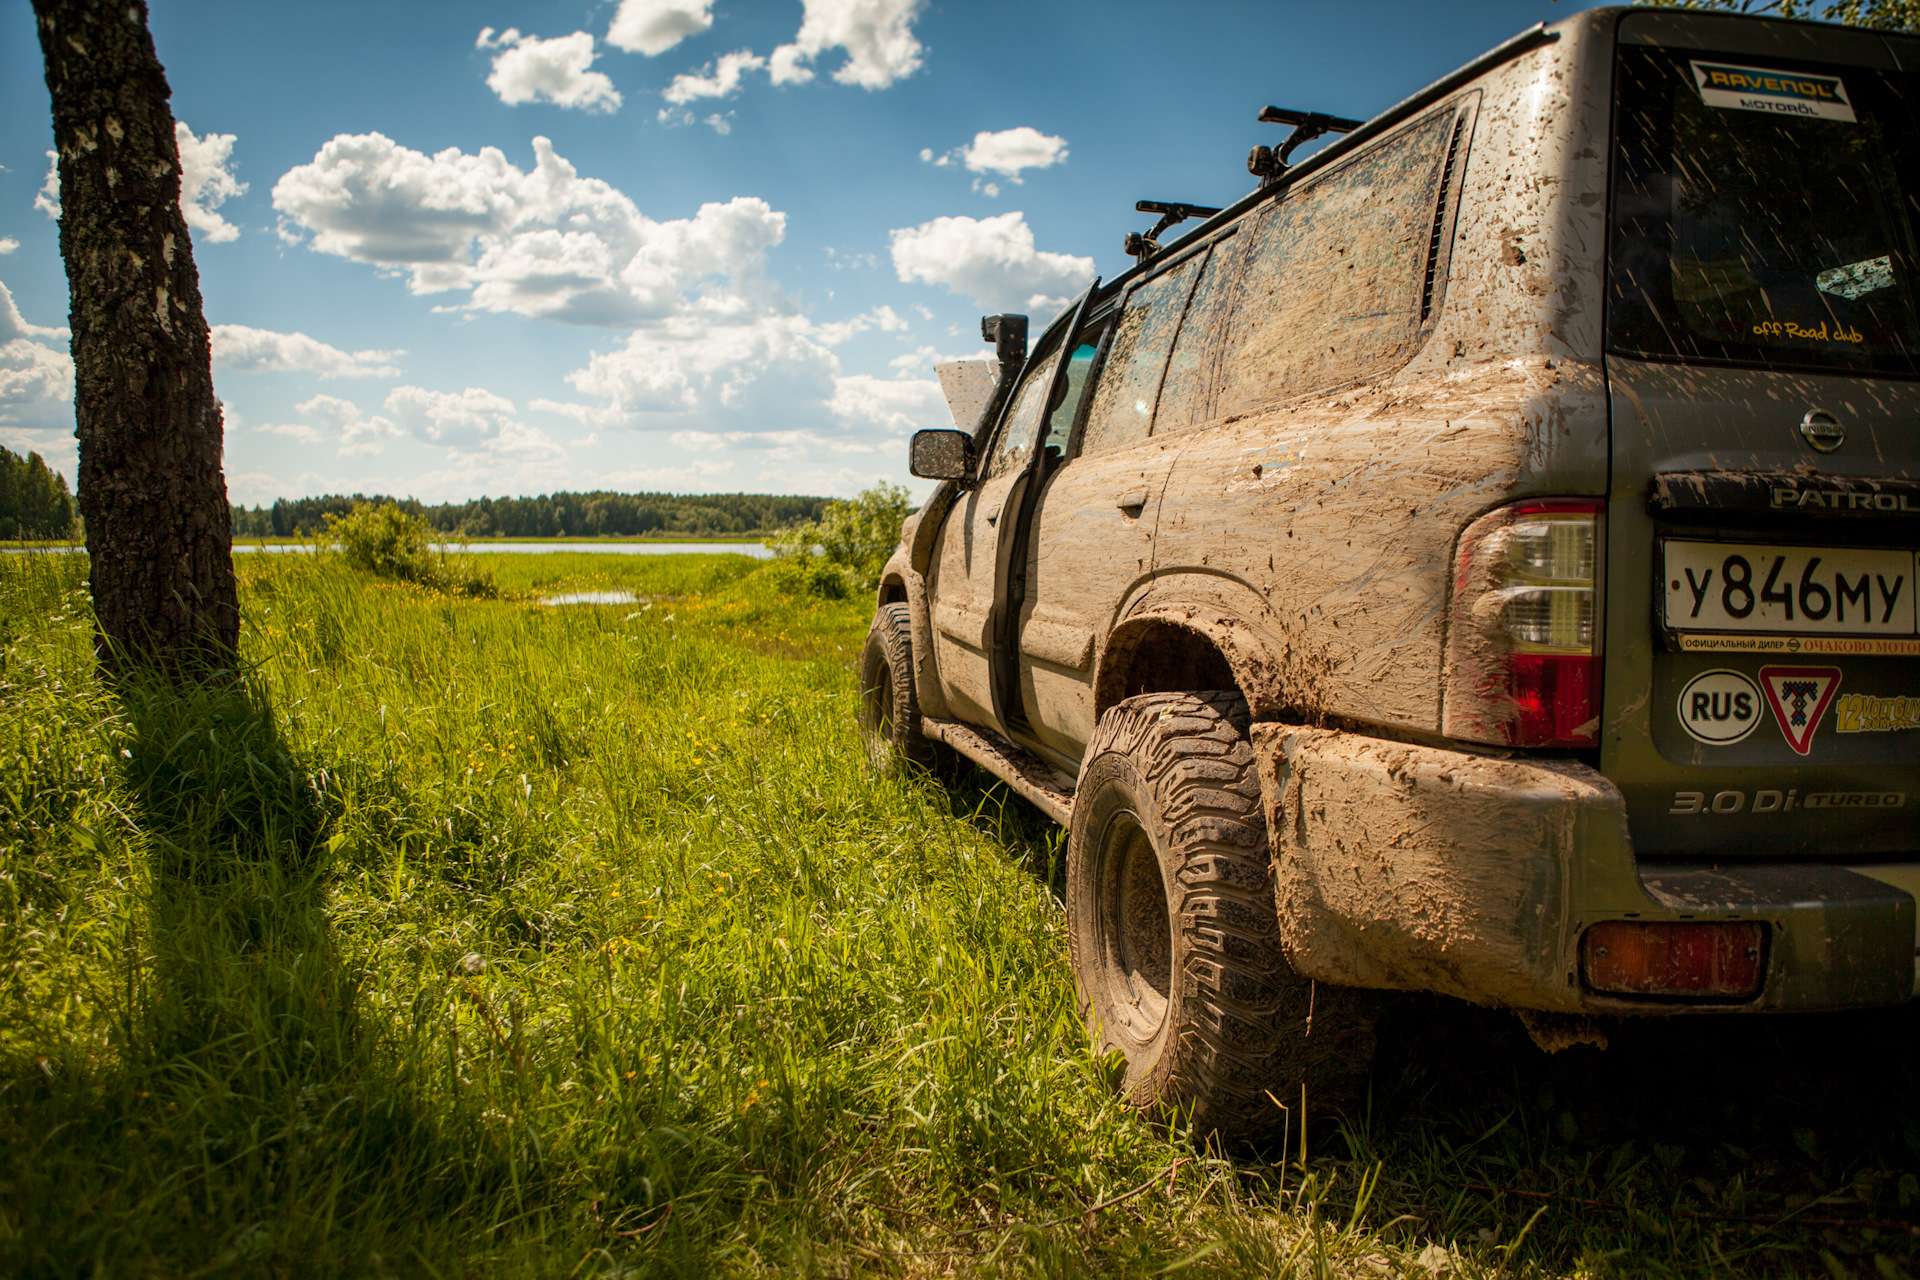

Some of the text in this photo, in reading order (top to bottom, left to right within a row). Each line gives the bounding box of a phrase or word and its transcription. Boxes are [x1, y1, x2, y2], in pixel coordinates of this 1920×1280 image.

[1710, 71, 1834, 98] RAVENOL
[1740, 98, 1820, 116] MOTORÖL
[1784, 321, 1829, 342] Road
[1833, 321, 1863, 343] club
[1808, 424, 1846, 436] NISSAN
[1773, 487, 1920, 512] PATROL
[1685, 638, 1920, 653] ОФИЦИАЛЬНЫЙ ДИЛЕР ОЧАКОВО МОТО
[1690, 691, 1753, 722] RUS
[1669, 788, 1900, 815] 3.0 Di TURBO
